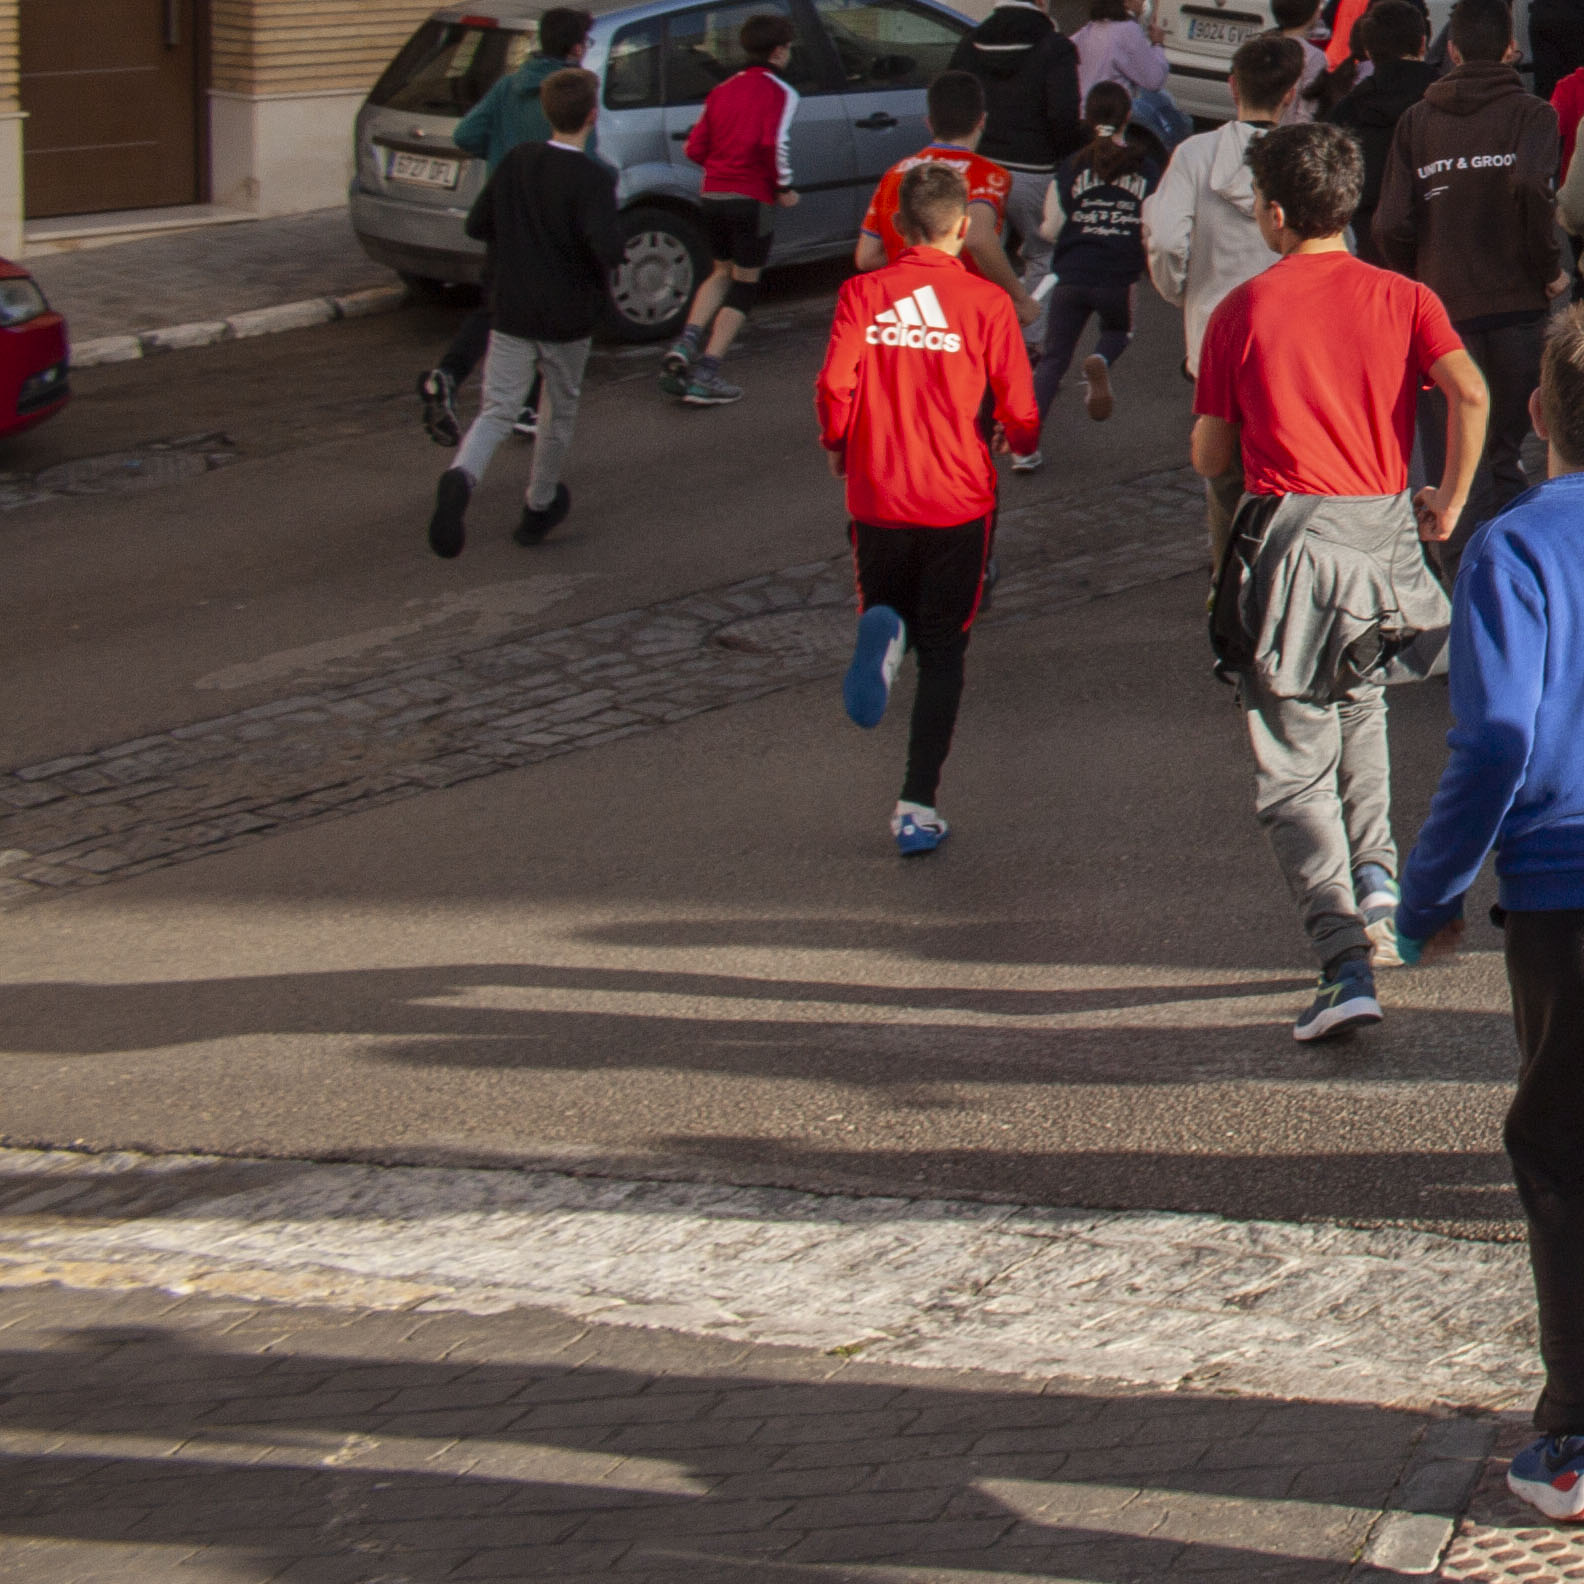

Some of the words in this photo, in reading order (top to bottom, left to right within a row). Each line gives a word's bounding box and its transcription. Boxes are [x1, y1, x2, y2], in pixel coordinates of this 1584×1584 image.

[1195, 22, 1225, 40] 9024
[1456, 157, 1468, 169] &
[865, 321, 961, 353] adidas
